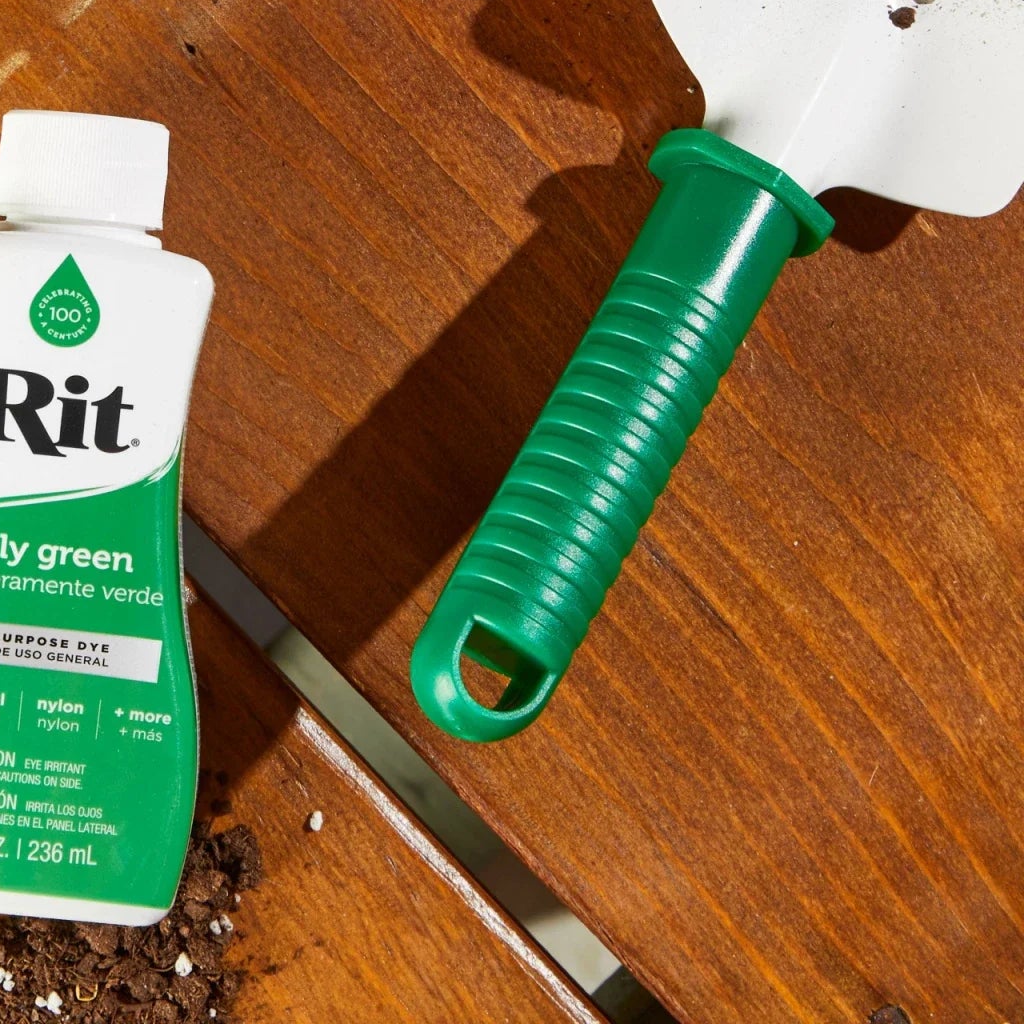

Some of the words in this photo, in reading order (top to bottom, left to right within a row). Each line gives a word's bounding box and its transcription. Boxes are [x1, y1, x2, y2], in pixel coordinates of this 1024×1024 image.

[39, 289, 92, 313] CELEBRATING
[49, 307, 81, 322] 100
[48, 324, 87, 340] CENTURY
[38, 543, 134, 573] green
[102, 584, 164, 606] verde
[77, 642, 110, 653] DYE
[15, 648, 42, 659] USO
[47, 652, 109, 667] GENERAL
[37, 699, 84, 716] nylon
[37, 717, 80, 733] nylon
[129, 710, 172, 726] more
[133, 727, 162, 742] más
[24, 759, 42, 770] EYE
[44, 761, 86, 775] IRRITANT
[44, 776, 58, 787] ON
[25, 801, 55, 814] IRRITA
[57, 804, 75, 816] LOS
[78, 806, 103, 819] OJOS
[17, 816, 30, 826] EN
[32, 817, 44, 829] EL
[46, 819, 76, 832] PANEL
[78, 822, 118, 836] LATERAL
[27, 840, 63, 863] 236
[69, 845, 97, 866] mL
